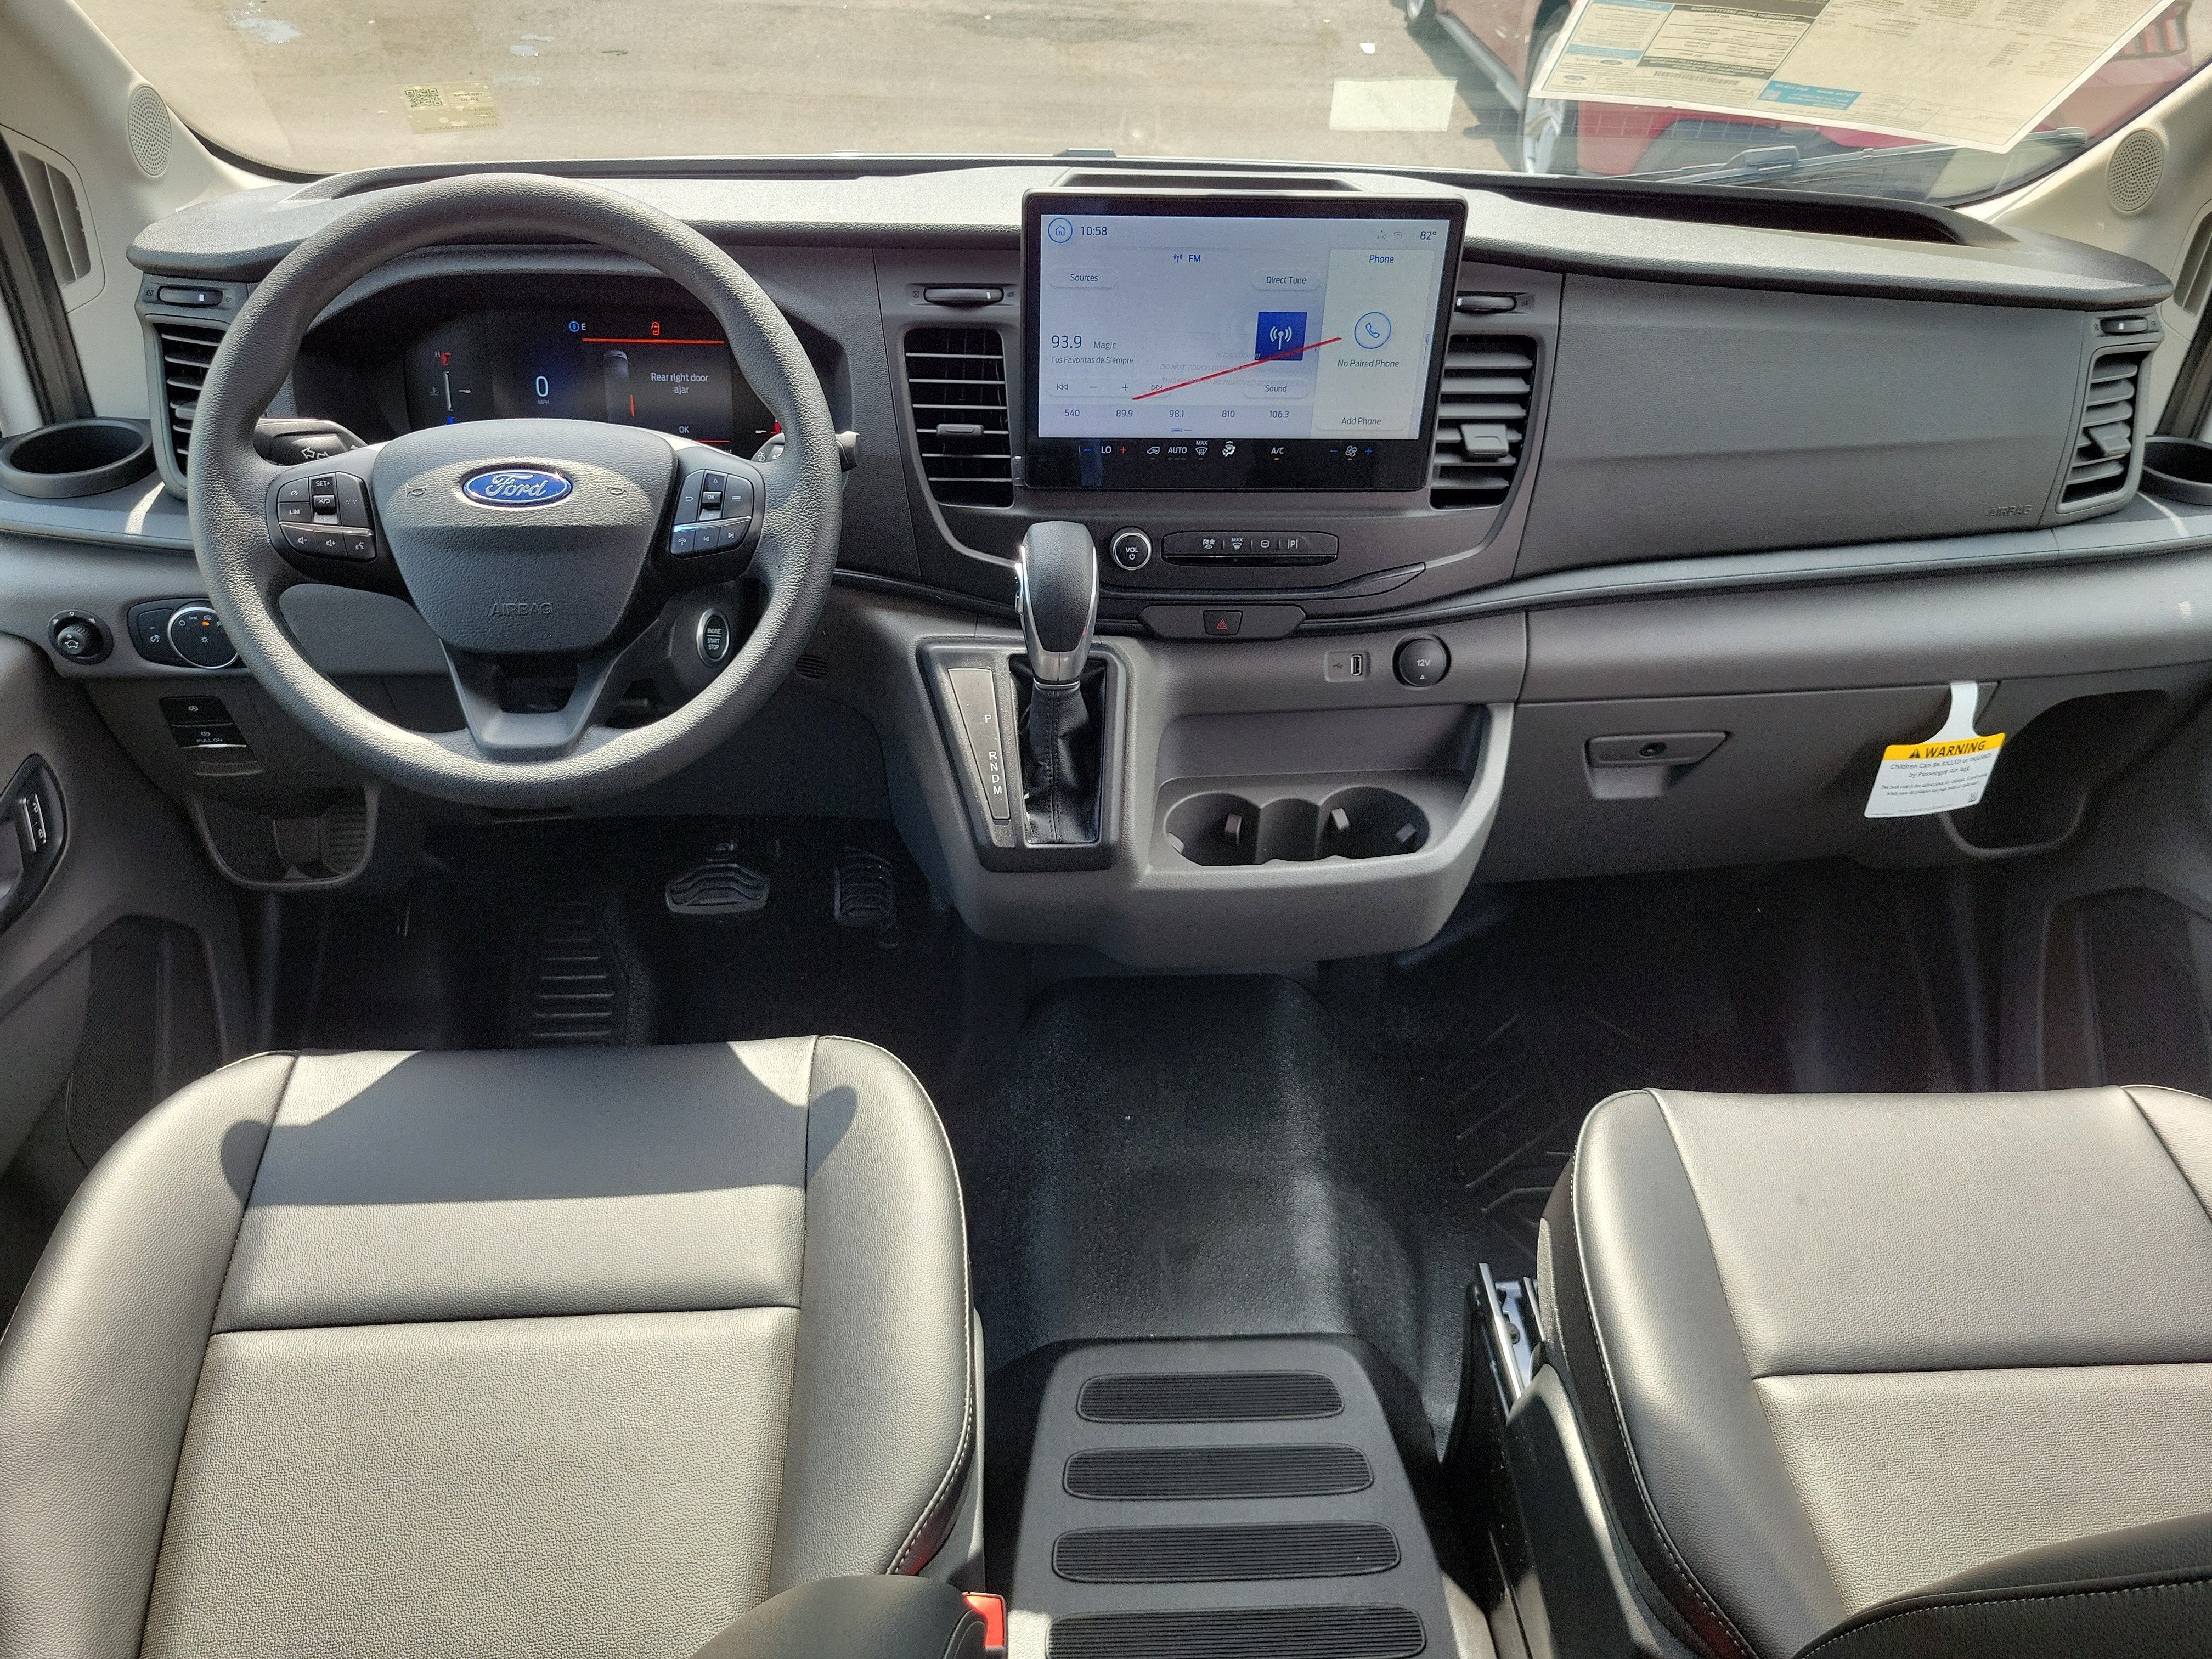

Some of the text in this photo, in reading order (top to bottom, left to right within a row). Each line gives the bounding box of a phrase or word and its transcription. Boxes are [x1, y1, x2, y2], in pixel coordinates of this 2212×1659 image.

[1080, 225, 1108, 236] 10:58
[1420, 230, 1437, 241] 82°
[1188, 255, 1201, 263] FM
[1369, 255, 1395, 263] Phone
[1266, 276, 1306, 285] Direct Tune
[1052, 335, 1082, 349] 93.9
[1094, 341, 1116, 351] Magic
[1106, 357, 1133, 365] Siempre
[1350, 359, 1374, 368] Paired
[651, 373, 709, 383] Rear right door
[535, 376, 549, 397] 0
[674, 385, 689, 395] ajar
[1265, 385, 1287, 393] Sound
[1065, 409, 1080, 417] 540
[1116, 409, 1133, 417] 89.9
[1169, 410, 1184, 418] 98.1
[1101, 445, 1111, 454] LO
[1167, 446, 1187, 454] AUTO
[1271, 447, 1284, 455] A/C
[486, 473, 549, 497] Ford
[487, 603, 552, 616] AIRBAG
[984, 714, 991, 723] P
[1926, 741, 1986, 758] WARNING
[989, 751, 997, 760] R
[990, 762, 998, 771] N
[991, 774, 1000, 783] D
[993, 786, 1002, 795] M
